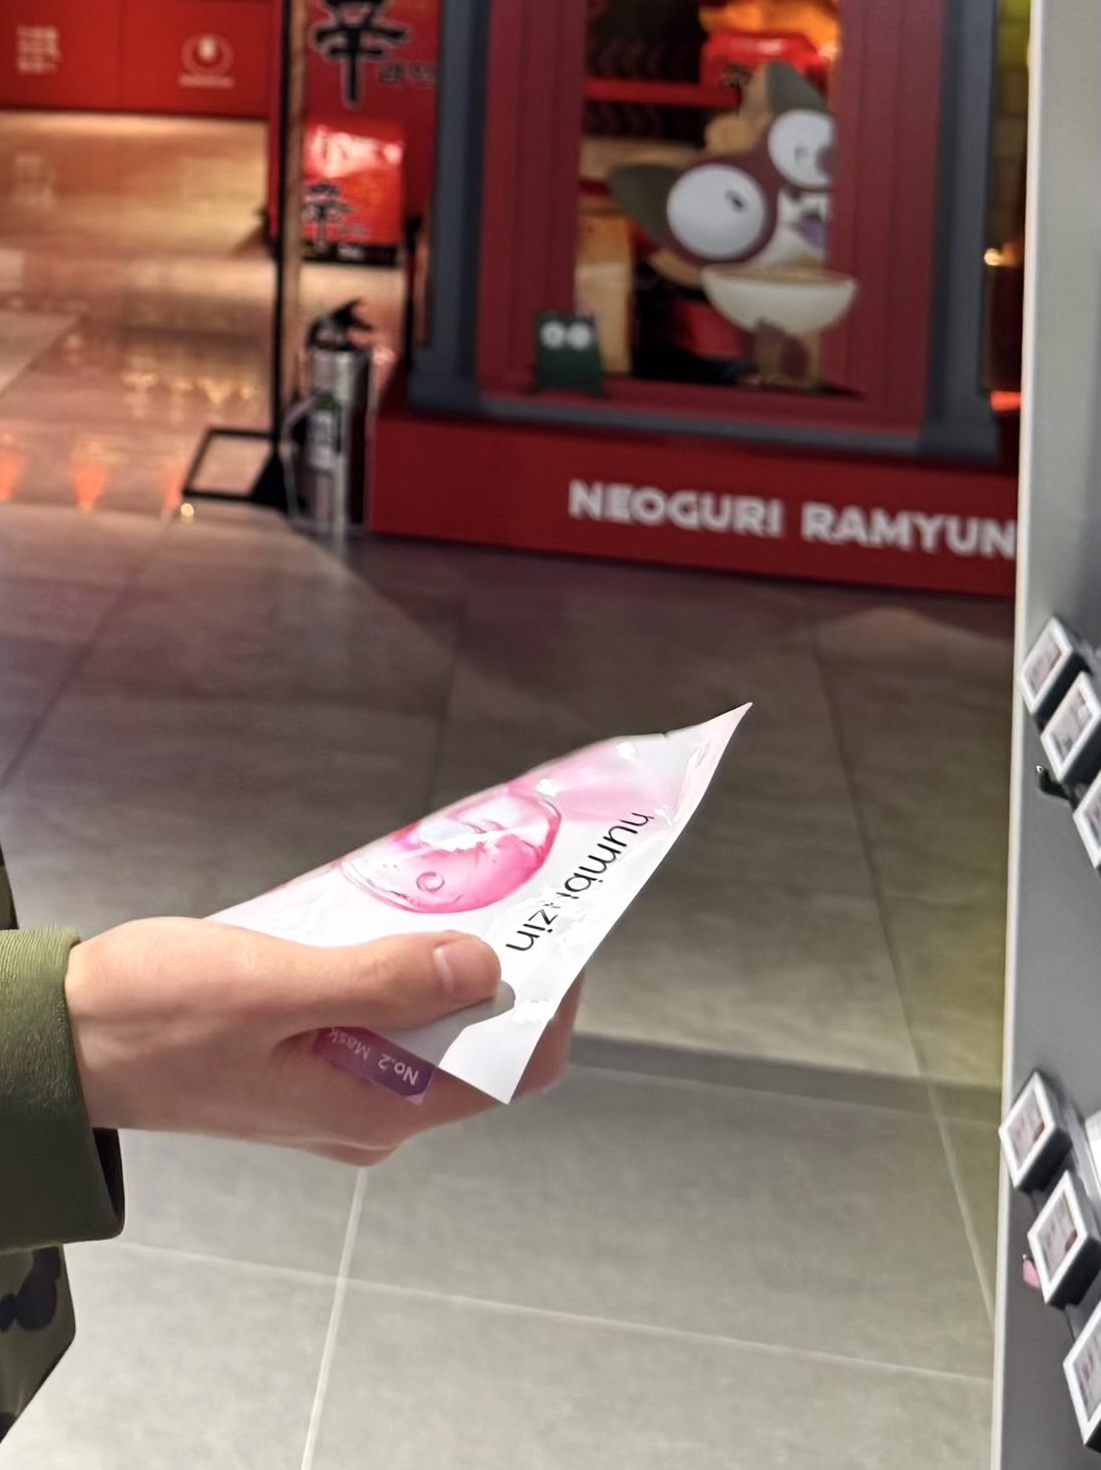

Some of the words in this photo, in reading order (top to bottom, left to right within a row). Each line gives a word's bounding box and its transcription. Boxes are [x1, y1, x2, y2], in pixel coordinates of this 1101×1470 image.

[568, 478, 784, 537] NEOGURI
[801, 501, 1017, 559] RAMYUN
[327, 1027, 371, 1061] Mask
[377, 1052, 419, 1086] No.2
